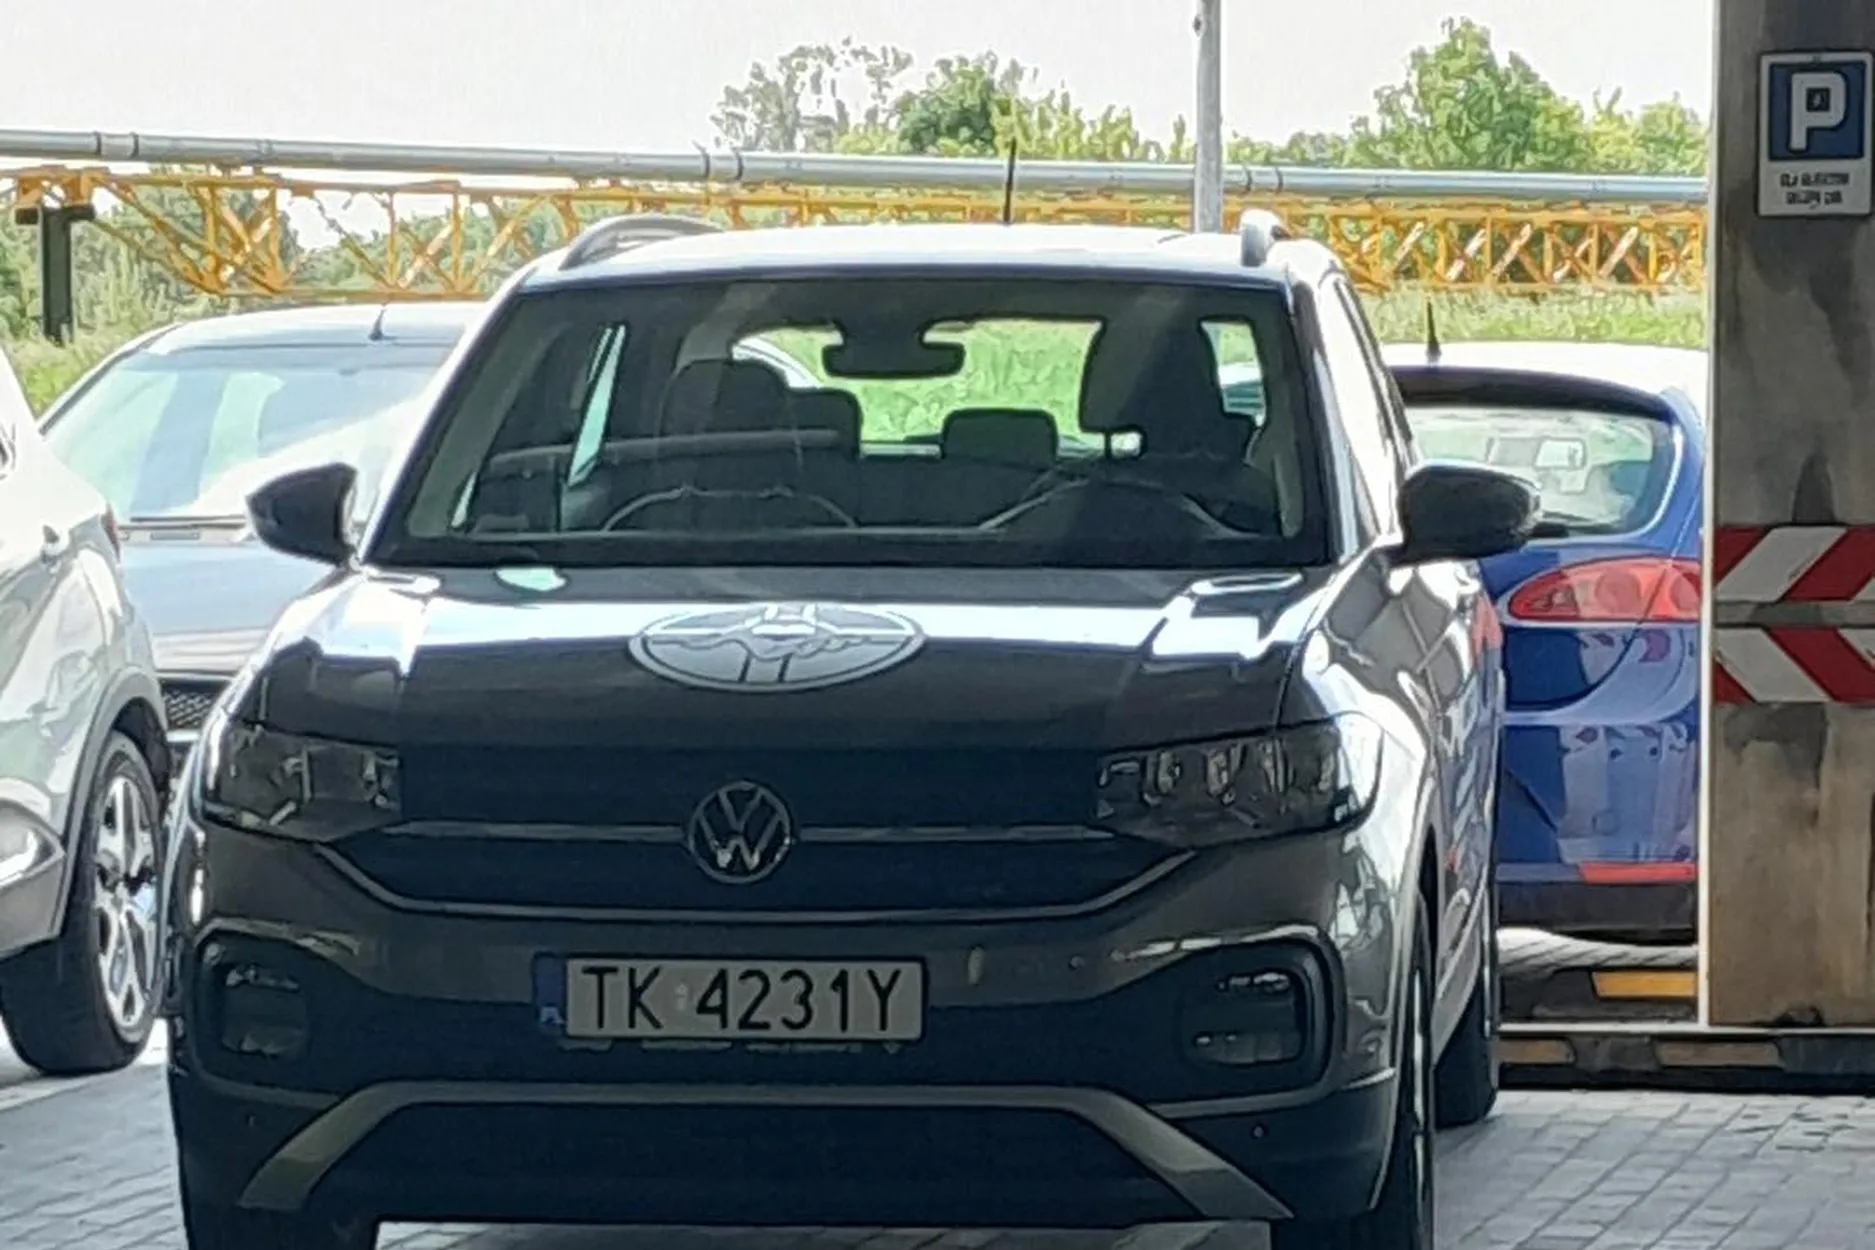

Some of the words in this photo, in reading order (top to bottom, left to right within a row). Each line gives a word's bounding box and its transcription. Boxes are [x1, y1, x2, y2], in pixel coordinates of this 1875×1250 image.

[1790, 72, 1846, 151] P
[691, 782, 789, 880] VW
[582, 966, 662, 1029] TK
[696, 968, 901, 1032] 4231Y
